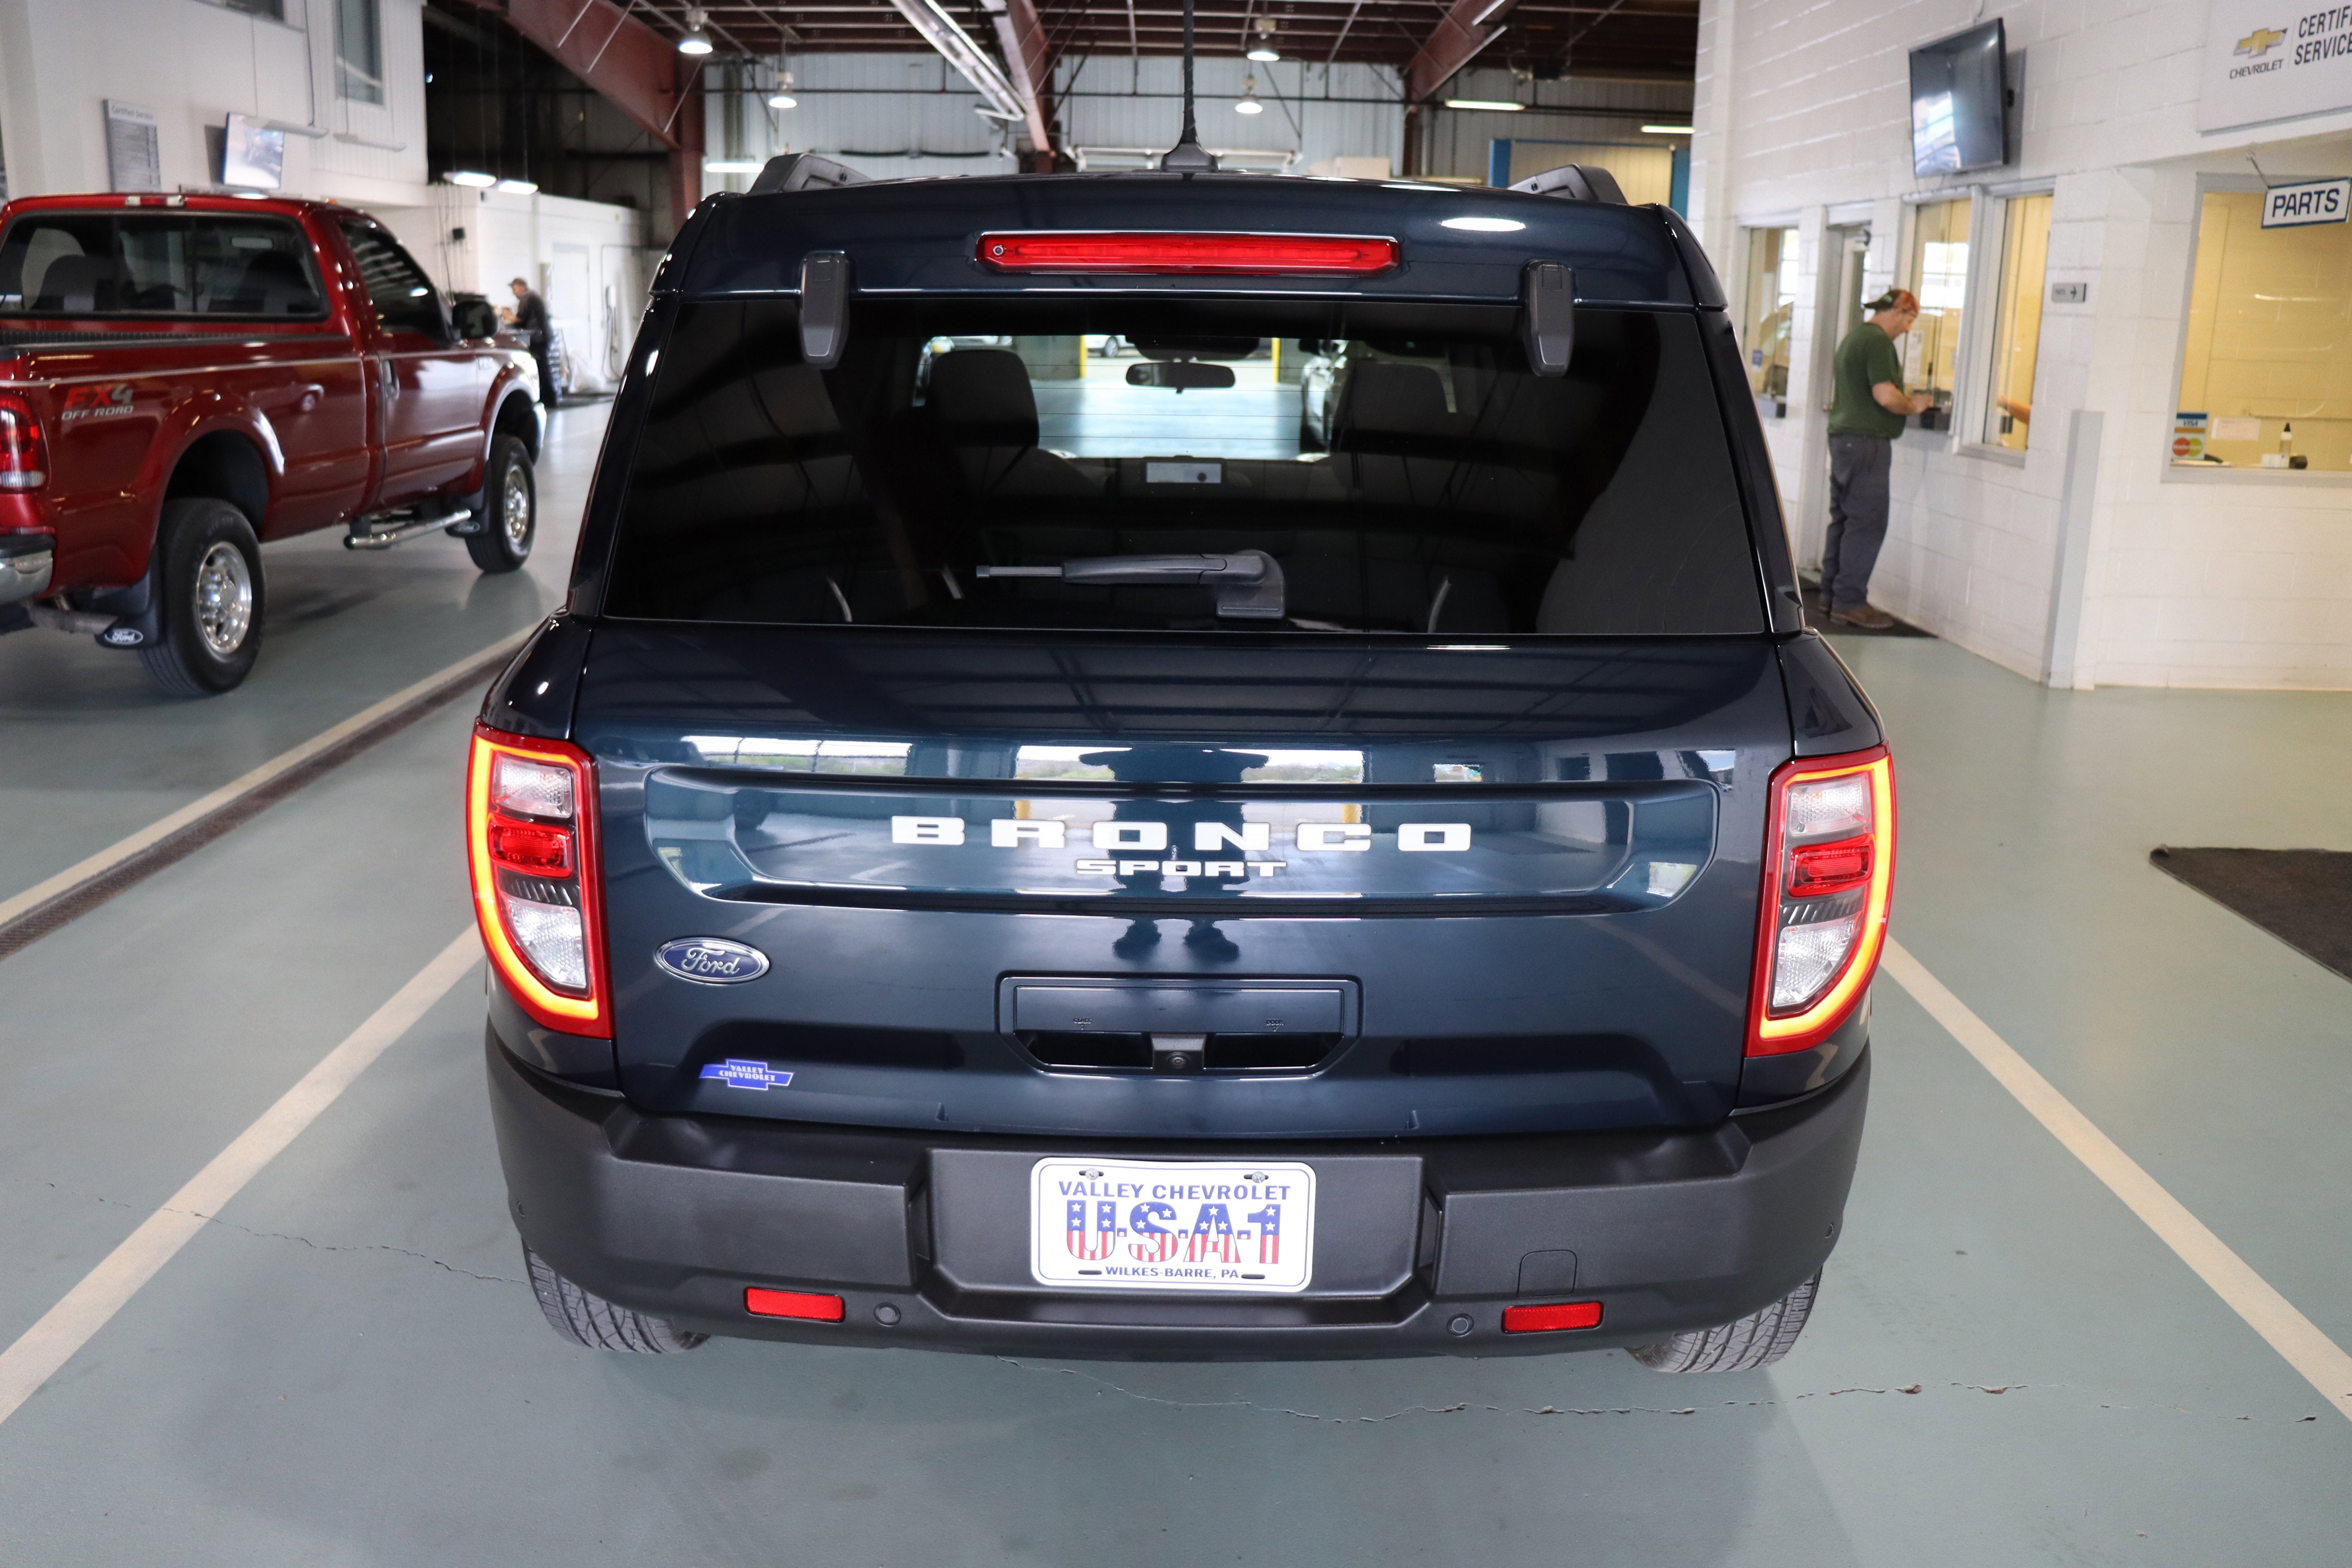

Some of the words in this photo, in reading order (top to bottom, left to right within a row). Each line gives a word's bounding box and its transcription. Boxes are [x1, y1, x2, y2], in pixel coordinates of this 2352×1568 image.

[2294, 31, 2352, 65] SERVICE
[2230, 58, 2284, 80] CHEVROLET
[2272, 187, 2340, 218] PARTS
[64, 382, 134, 410] FX4
[61, 409, 90, 421] OFF
[94, 405, 134, 417] ROAD
[891, 815, 1471, 852] BRONCO
[1075, 859, 1287, 878] SPORT
[681, 947, 740, 975] Ford
[719, 1070, 775, 1081] CHEVROLET
[730, 1065, 764, 1074] VALLEY
[1058, 1181, 1144, 1198] VALLEY
[1152, 1185, 1291, 1200] CHEVROLET
[1105, 1266, 1216, 1279] WILKES-BARRE,
[1221, 1269, 1239, 1278] PA
